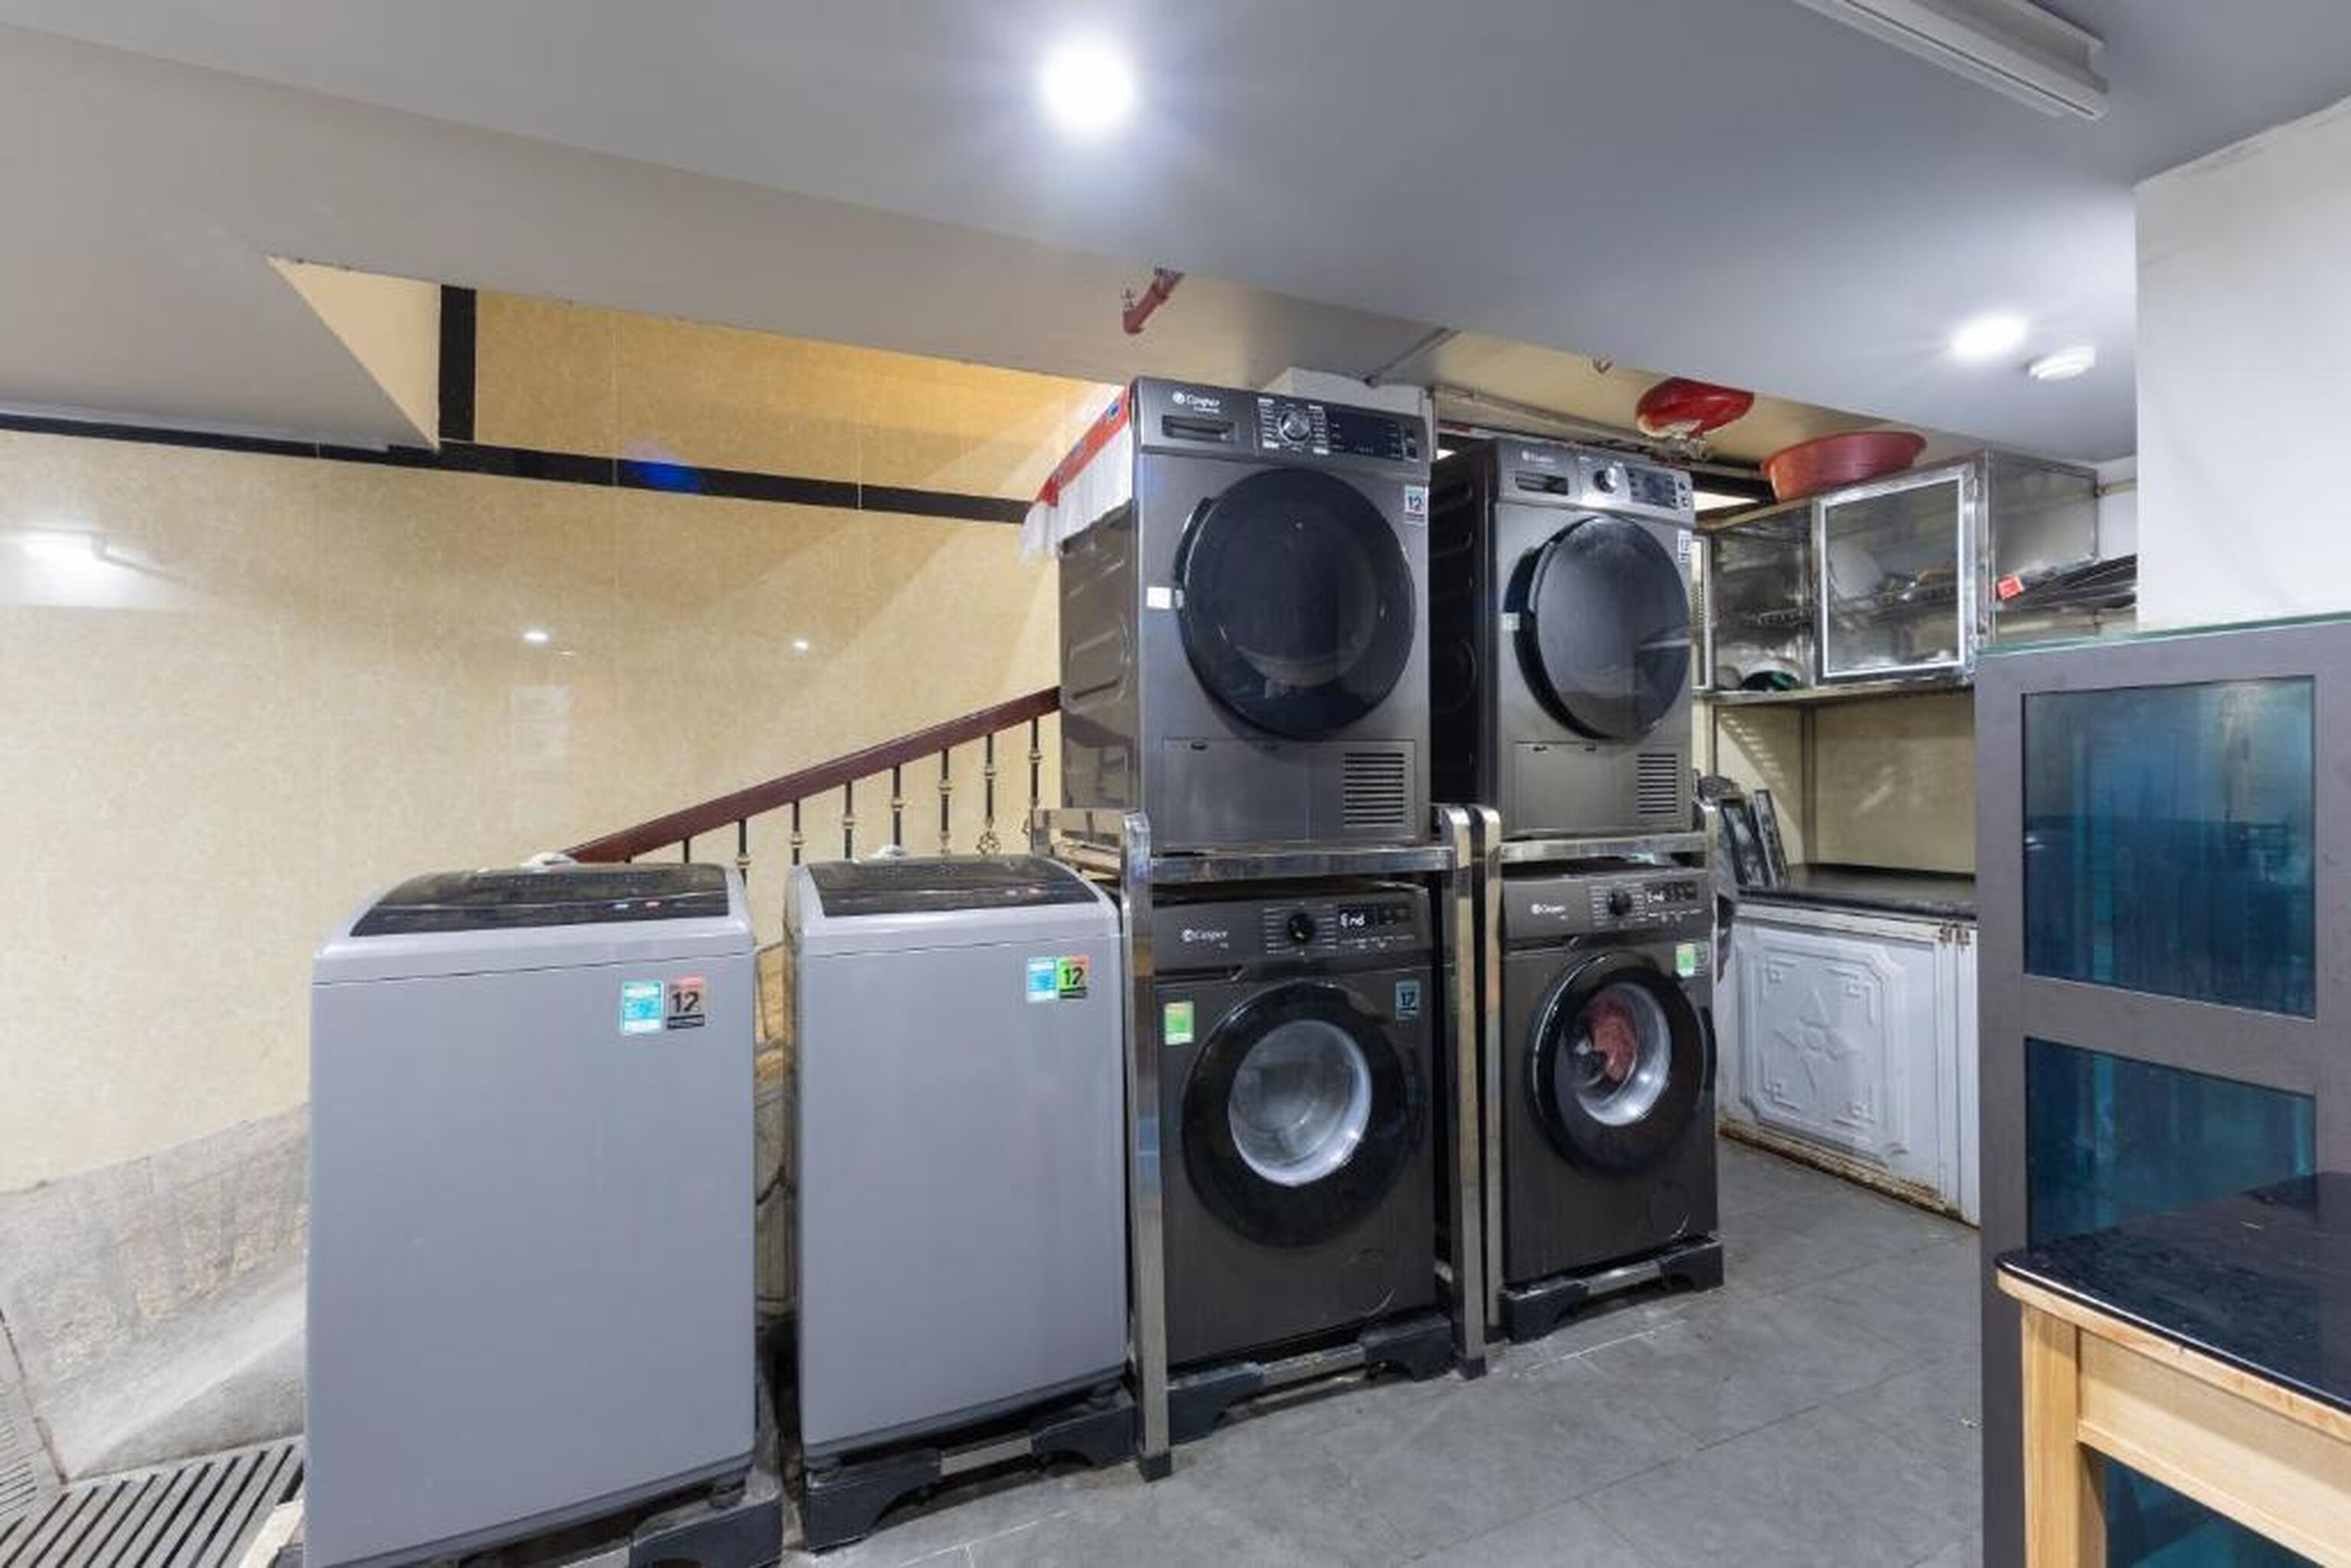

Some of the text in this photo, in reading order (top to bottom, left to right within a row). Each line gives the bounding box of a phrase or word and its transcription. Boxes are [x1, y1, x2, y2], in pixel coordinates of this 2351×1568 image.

[1407, 496, 1423, 510] 12
[1063, 967, 1084, 985] 12
[672, 991, 700, 1012] 12
